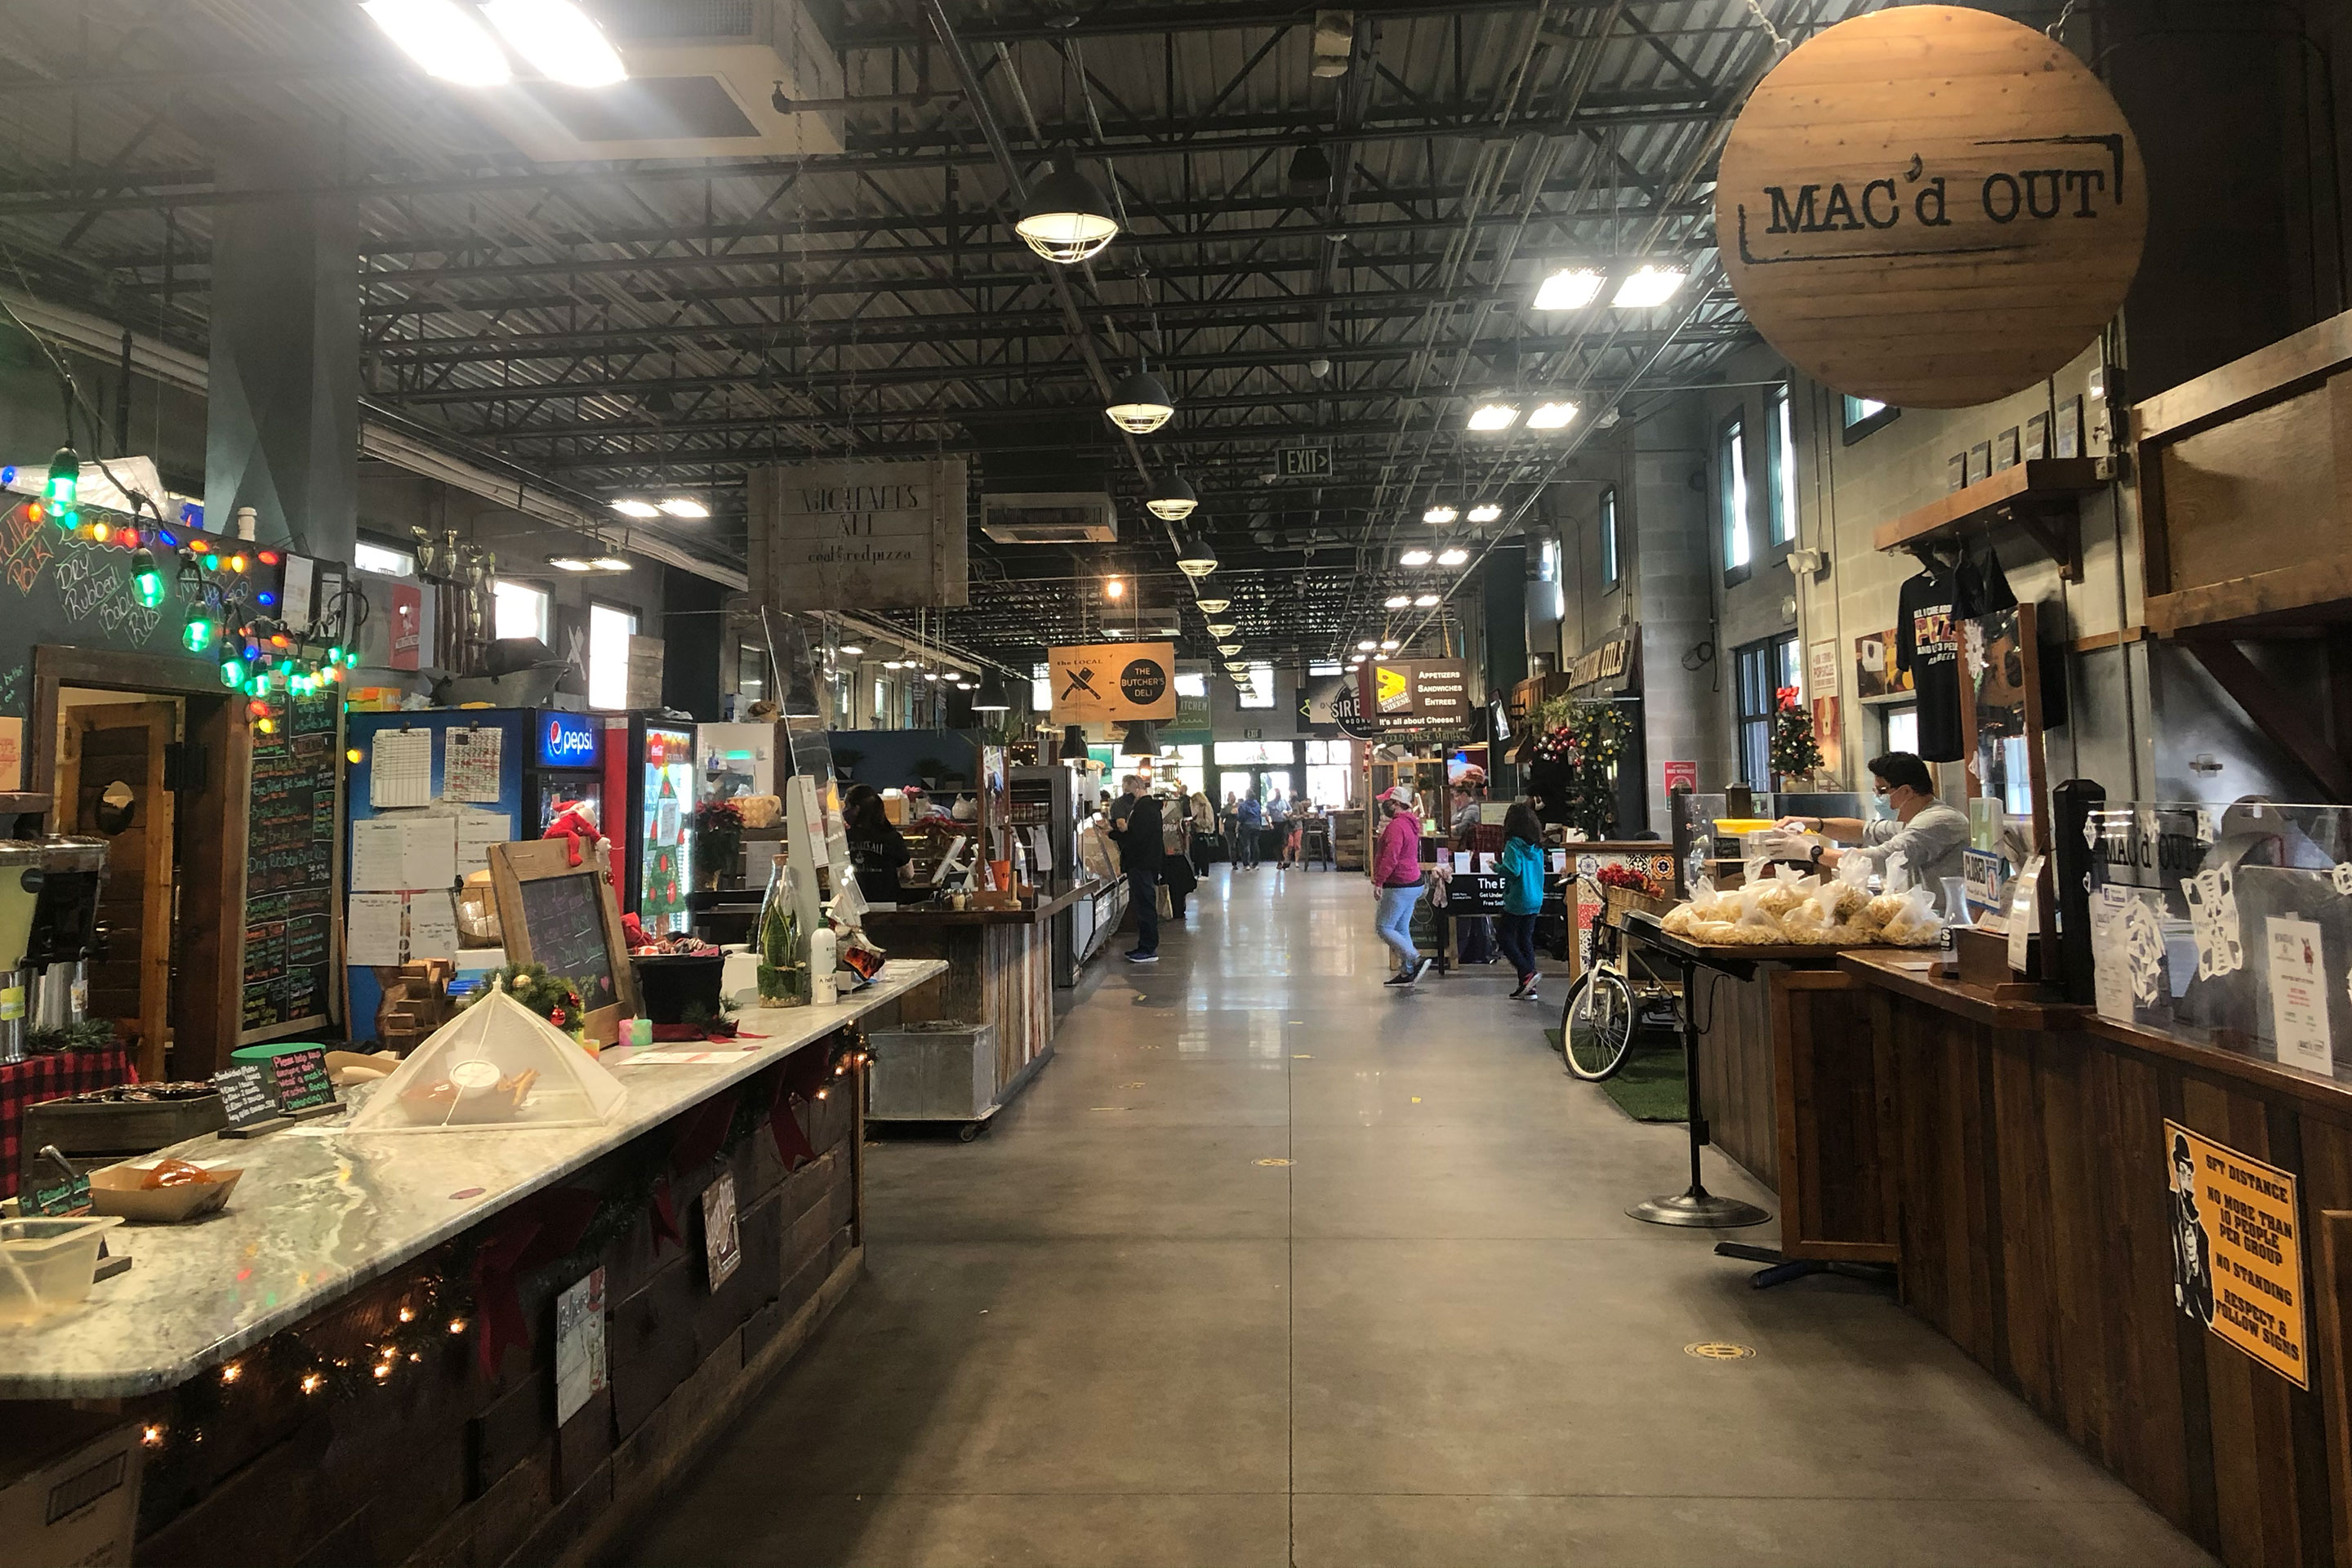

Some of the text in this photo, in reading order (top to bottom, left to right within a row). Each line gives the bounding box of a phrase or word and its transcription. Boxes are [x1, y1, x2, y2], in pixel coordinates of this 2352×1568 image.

[1764, 154, 2105, 234] MAC'd OUT
[1287, 450, 1317, 474] EXIT
[56, 555, 89, 590] DRY
[65, 567, 122, 619] Rubbed
[1601, 639, 1624, 677] OILS
[1121, 678, 1165, 687] BUTCHER'S
[1180, 701, 1207, 710] ITCHEN
[1331, 700, 1352, 719] SIR
[1427, 715, 1454, 724] Cheese
[564, 729, 593, 755] pepsi
[1247, 729, 1258, 738] EXIT
[1385, 734, 1405, 743] COLD
[1406, 733, 1432, 742] CHEESE
[1477, 878, 1498, 889] The
[273, 1057, 295, 1068] Please
[2229, 1164, 2288, 1204] DISTANCE
[2207, 1186, 2292, 1241] NO MORE THAN
[2220, 1208, 2280, 1250] 10 PEOPLE
[2219, 1223, 2283, 1267] PER GROUP
[2216, 1251, 2293, 1307] NO STANDING
[2216, 1298, 2300, 1361] FOLLOW SIGNS
[2223, 1288, 2287, 1336] RESPECT &
